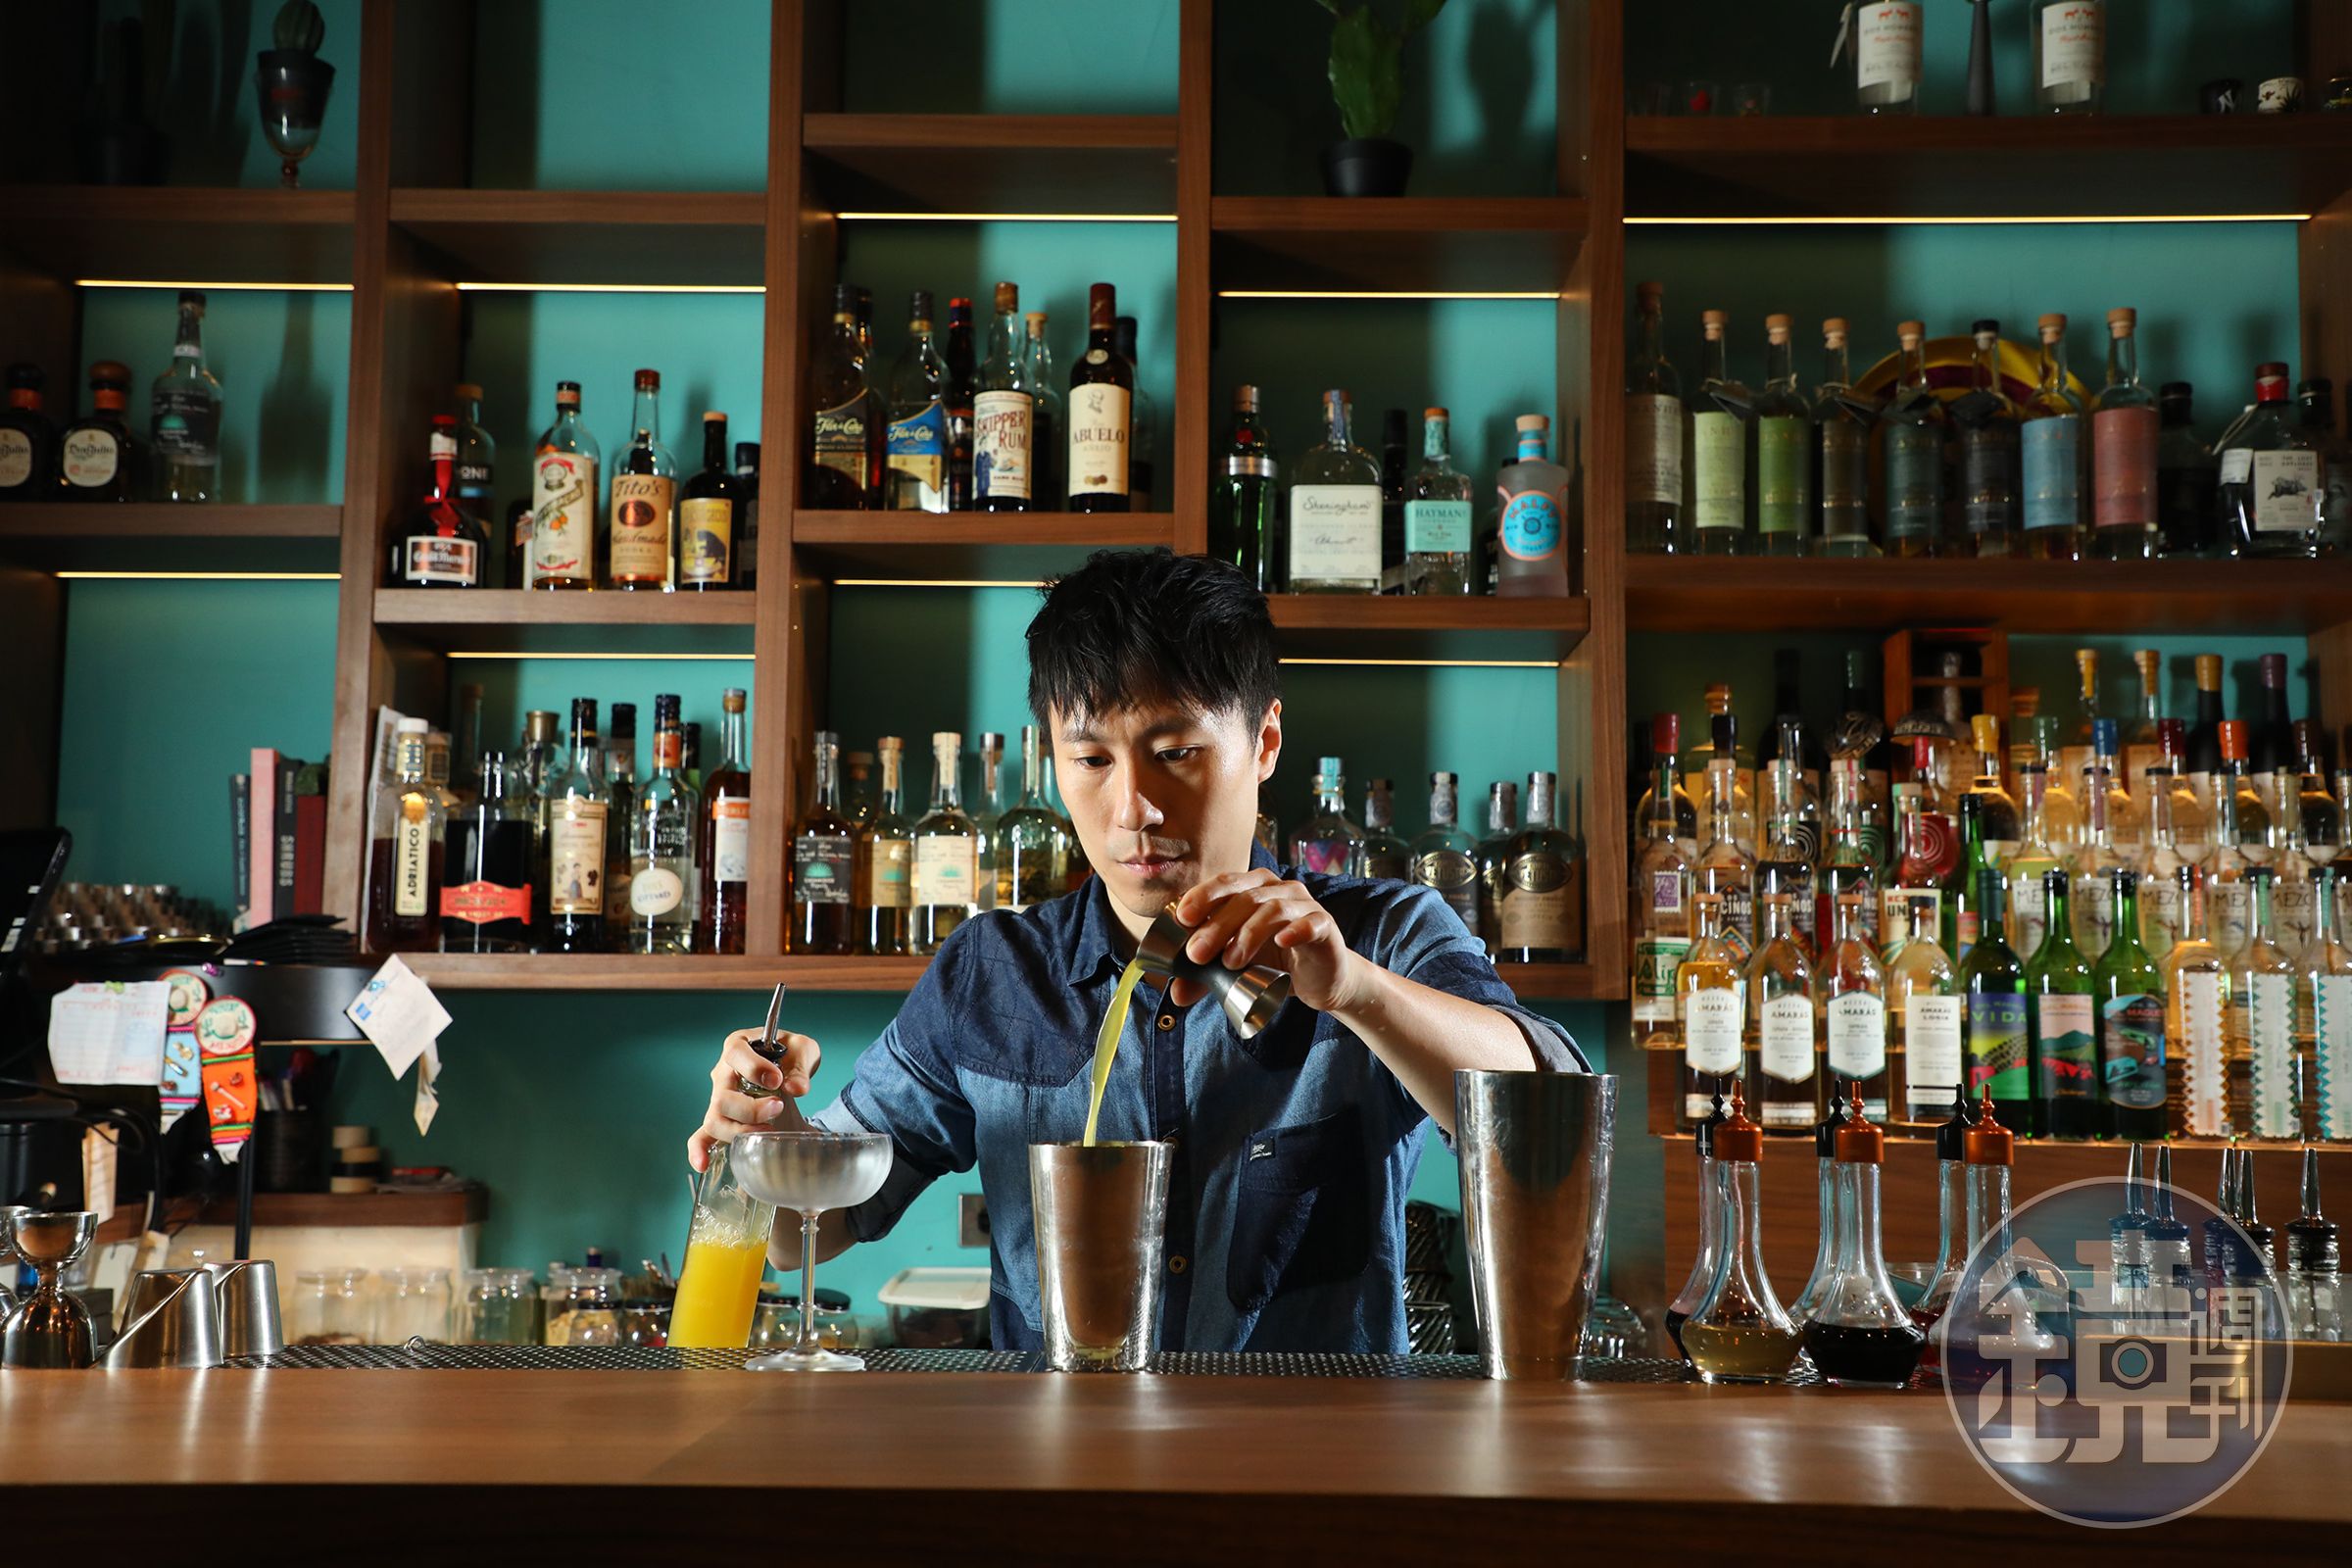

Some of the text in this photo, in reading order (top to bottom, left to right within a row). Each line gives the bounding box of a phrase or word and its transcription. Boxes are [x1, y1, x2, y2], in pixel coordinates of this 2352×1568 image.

[977, 411, 1026, 434] SKIPPER
[999, 429, 1027, 450] RUM
[1073, 427, 1125, 444] ABUELO
[613, 479, 662, 497] Tito's
[408, 827, 420, 899] ADRIATICO
[1971, 1010, 2028, 1024] VIDA
